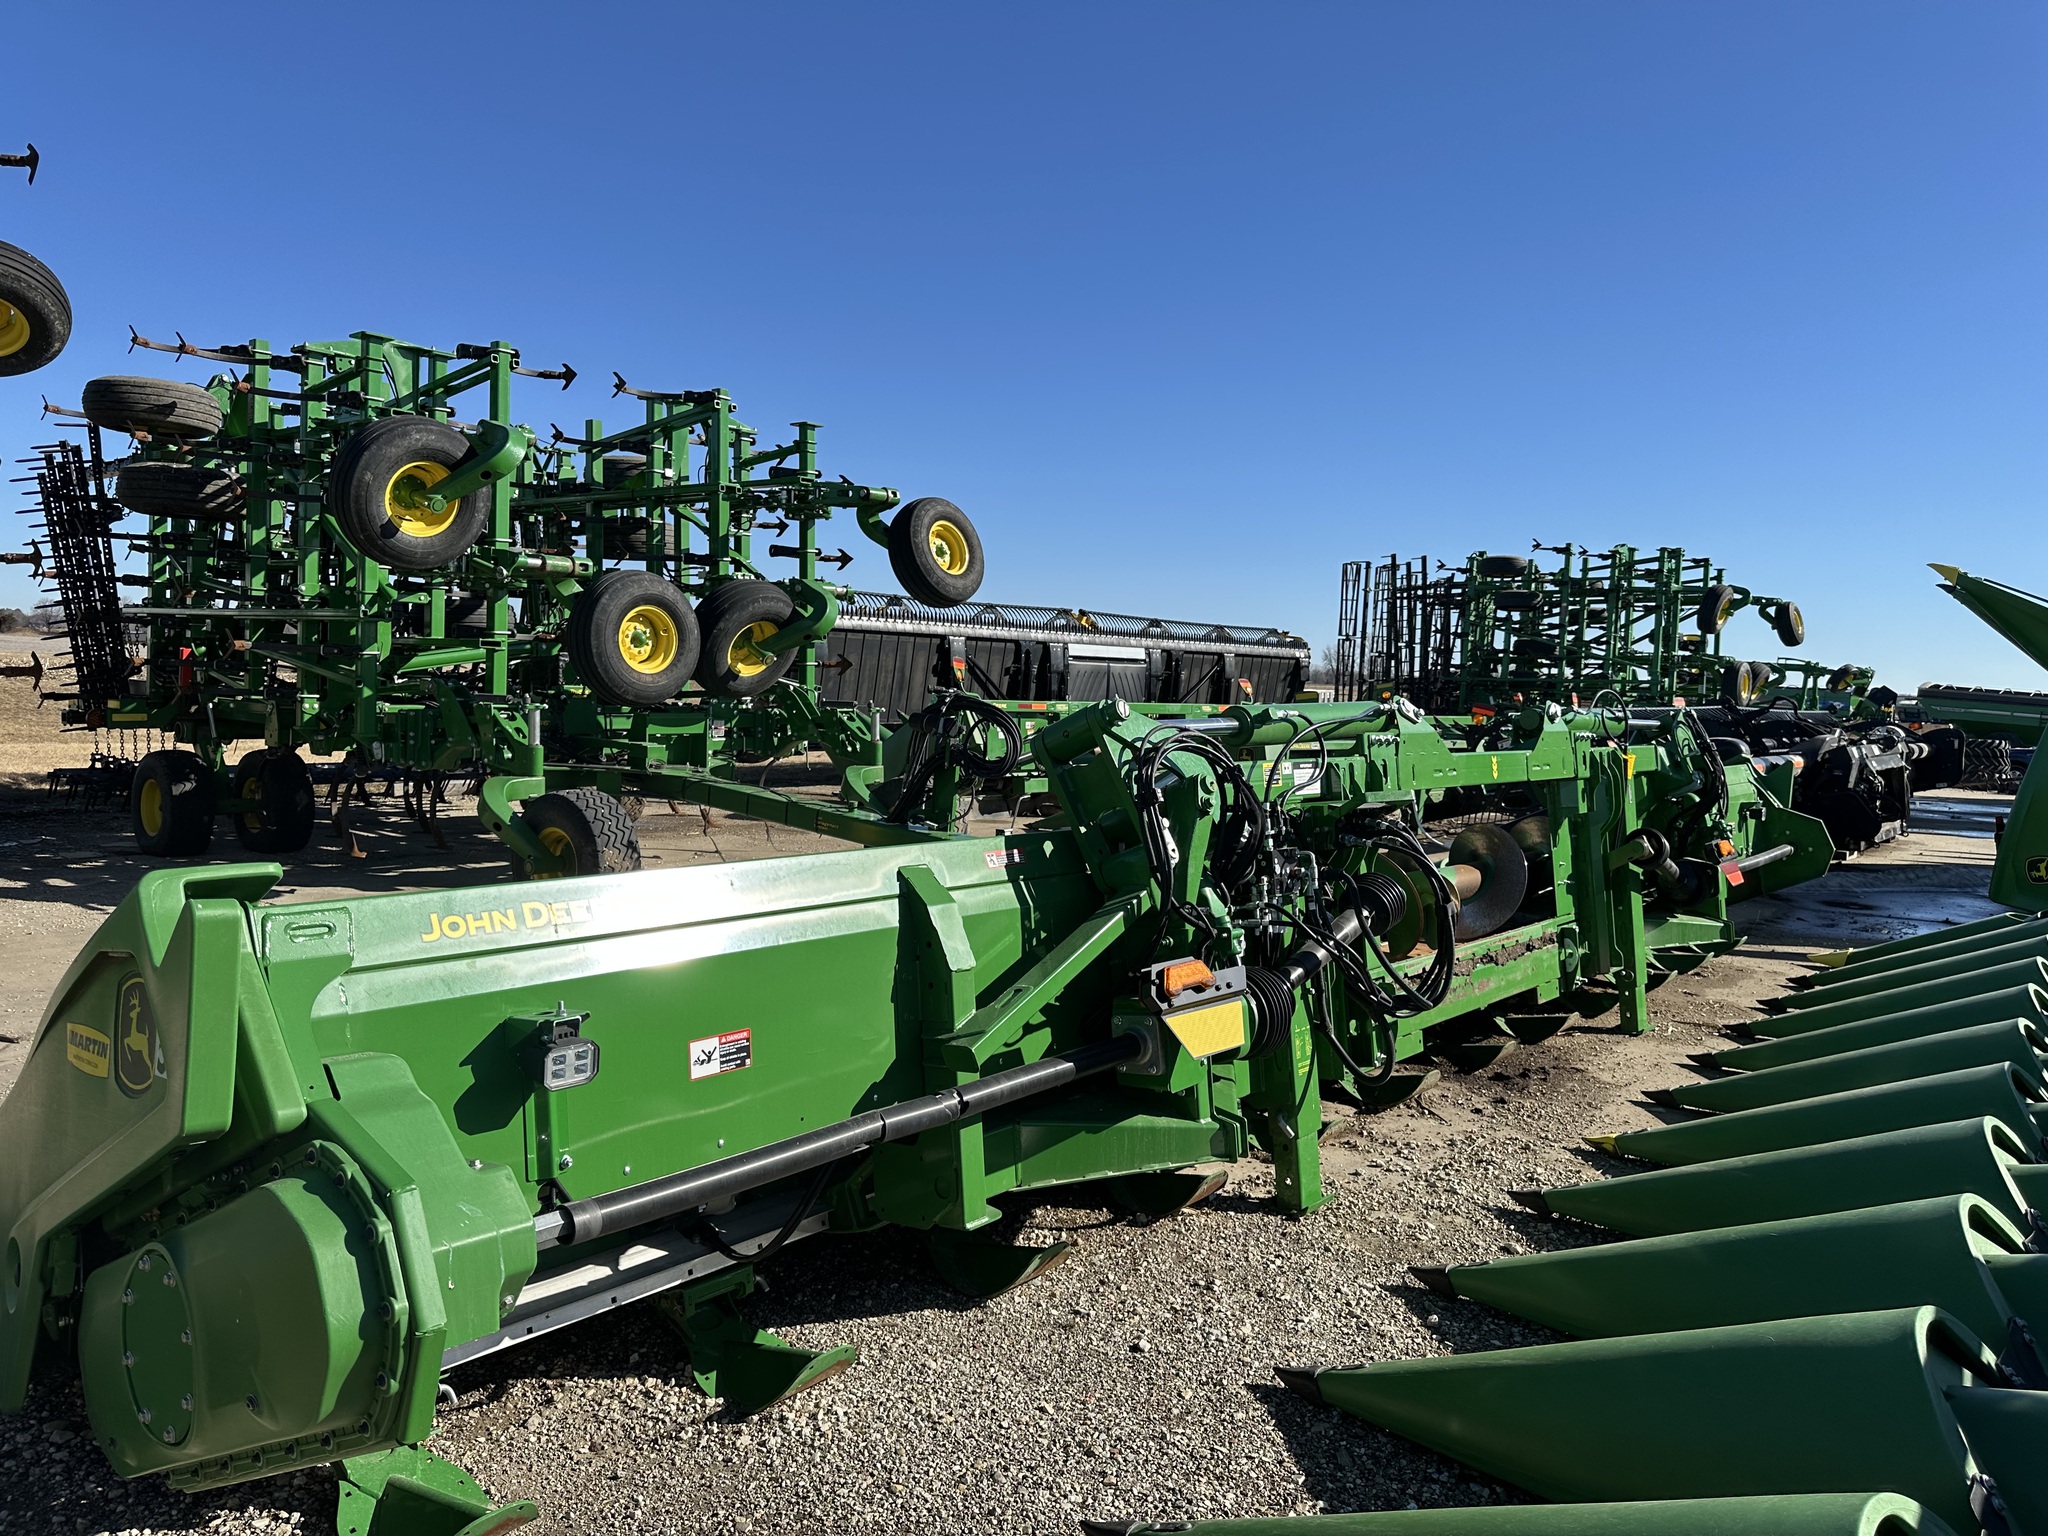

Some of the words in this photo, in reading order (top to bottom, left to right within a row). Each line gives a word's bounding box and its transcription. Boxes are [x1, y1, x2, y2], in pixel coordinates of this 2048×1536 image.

[421, 908, 517, 943] JOHN
[69, 1030, 109, 1059] MARTIN
[726, 1031, 749, 1041] DANGER
